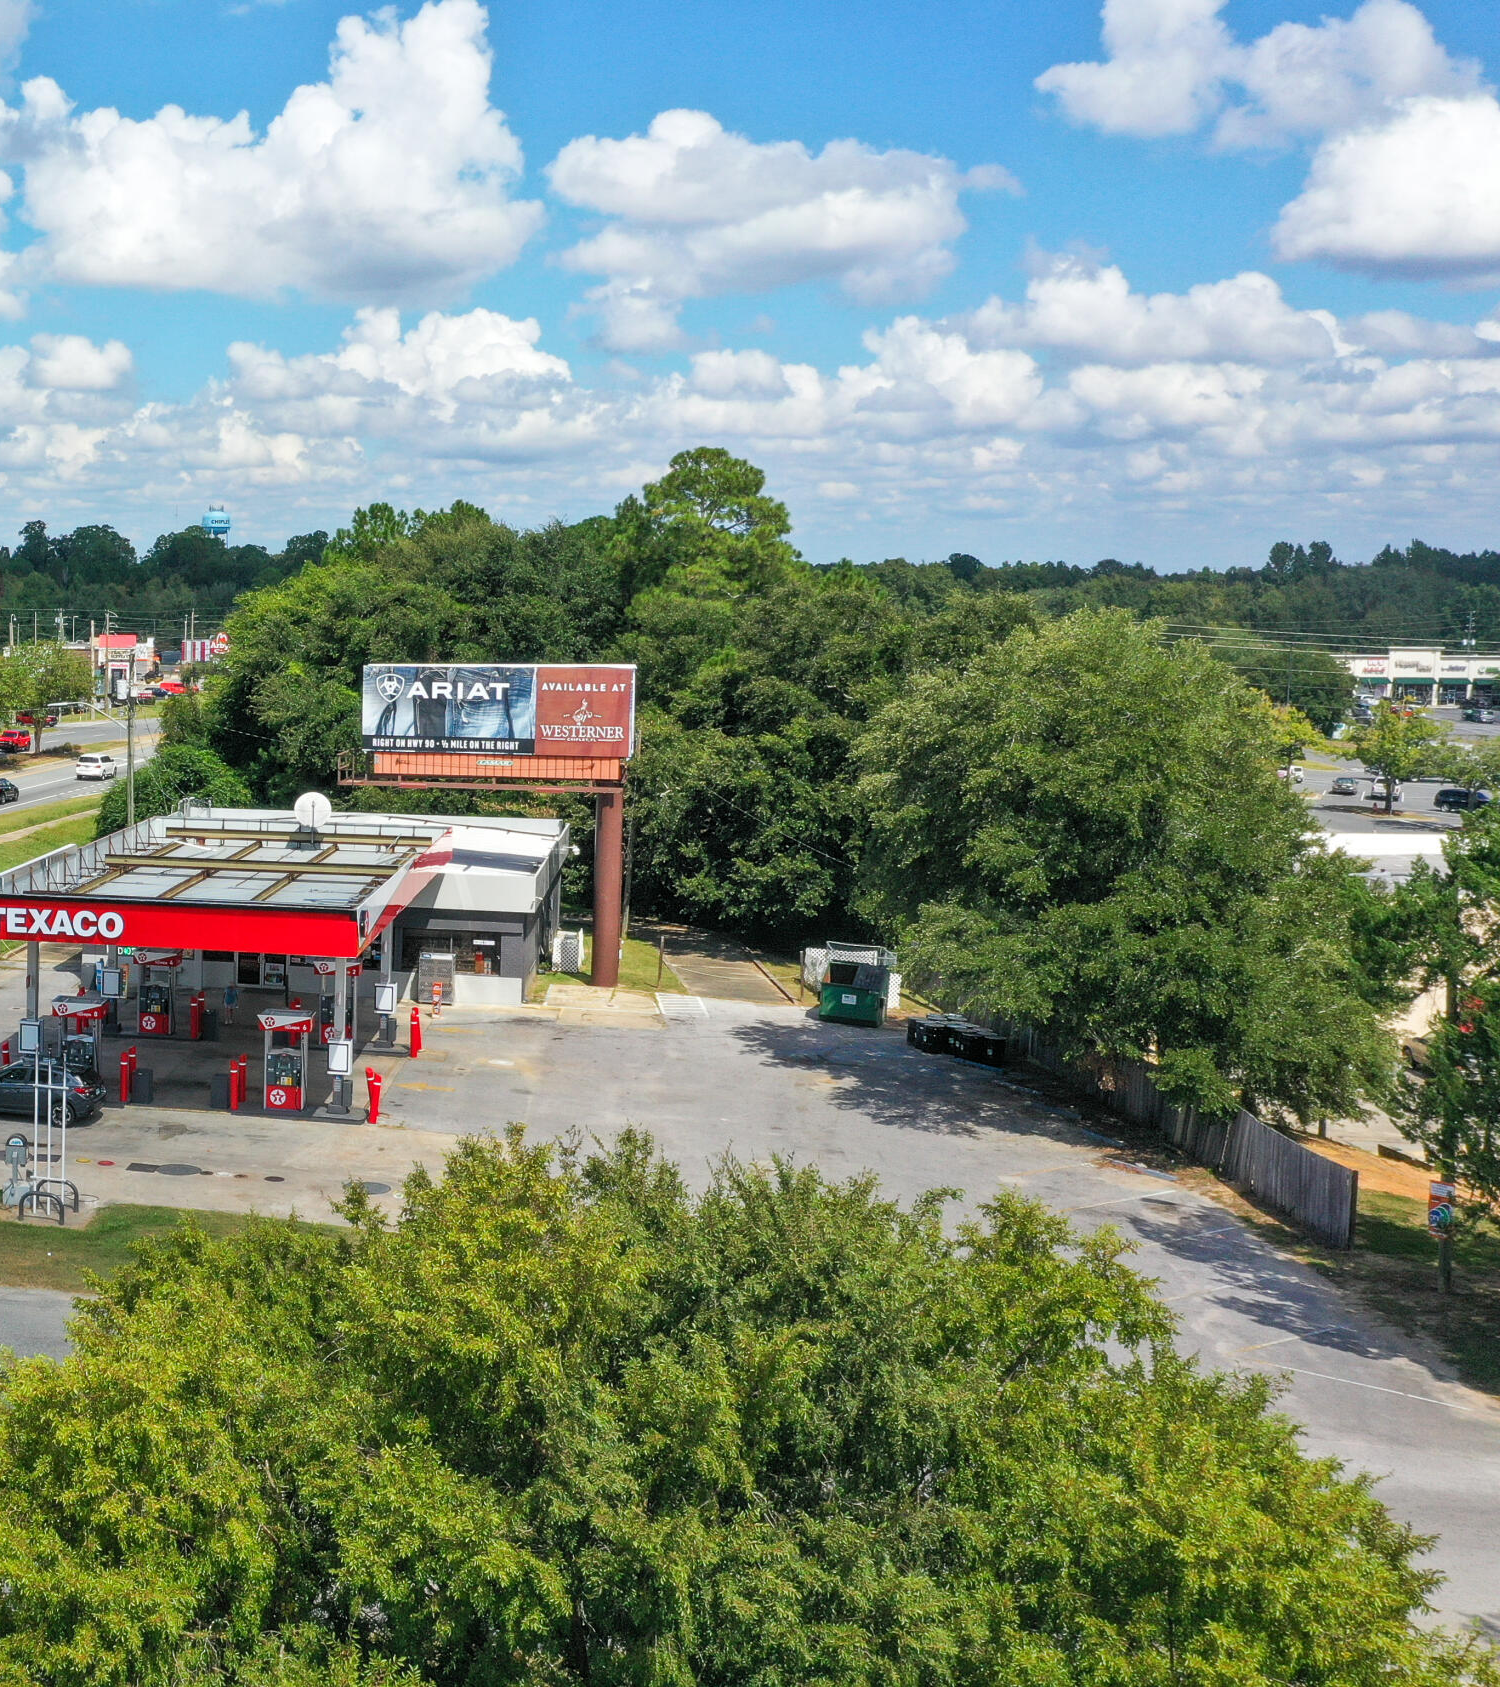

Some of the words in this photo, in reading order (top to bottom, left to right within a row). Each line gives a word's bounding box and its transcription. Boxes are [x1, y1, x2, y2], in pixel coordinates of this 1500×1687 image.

[406, 681, 510, 700] ARIAT
[541, 682, 607, 692] AVAILABLE
[611, 683, 626, 692] AT
[539, 724, 624, 739] WESTERNER
[372, 738, 394, 747] RIGHT
[395, 739, 406, 747] ON
[407, 739, 423, 748] HWY
[424, 740, 435, 748] 90
[450, 740, 468, 749] MILE
[469, 740, 480, 749] ON
[481, 741, 495, 749] THE
[496, 741, 520, 750] RIGHT
